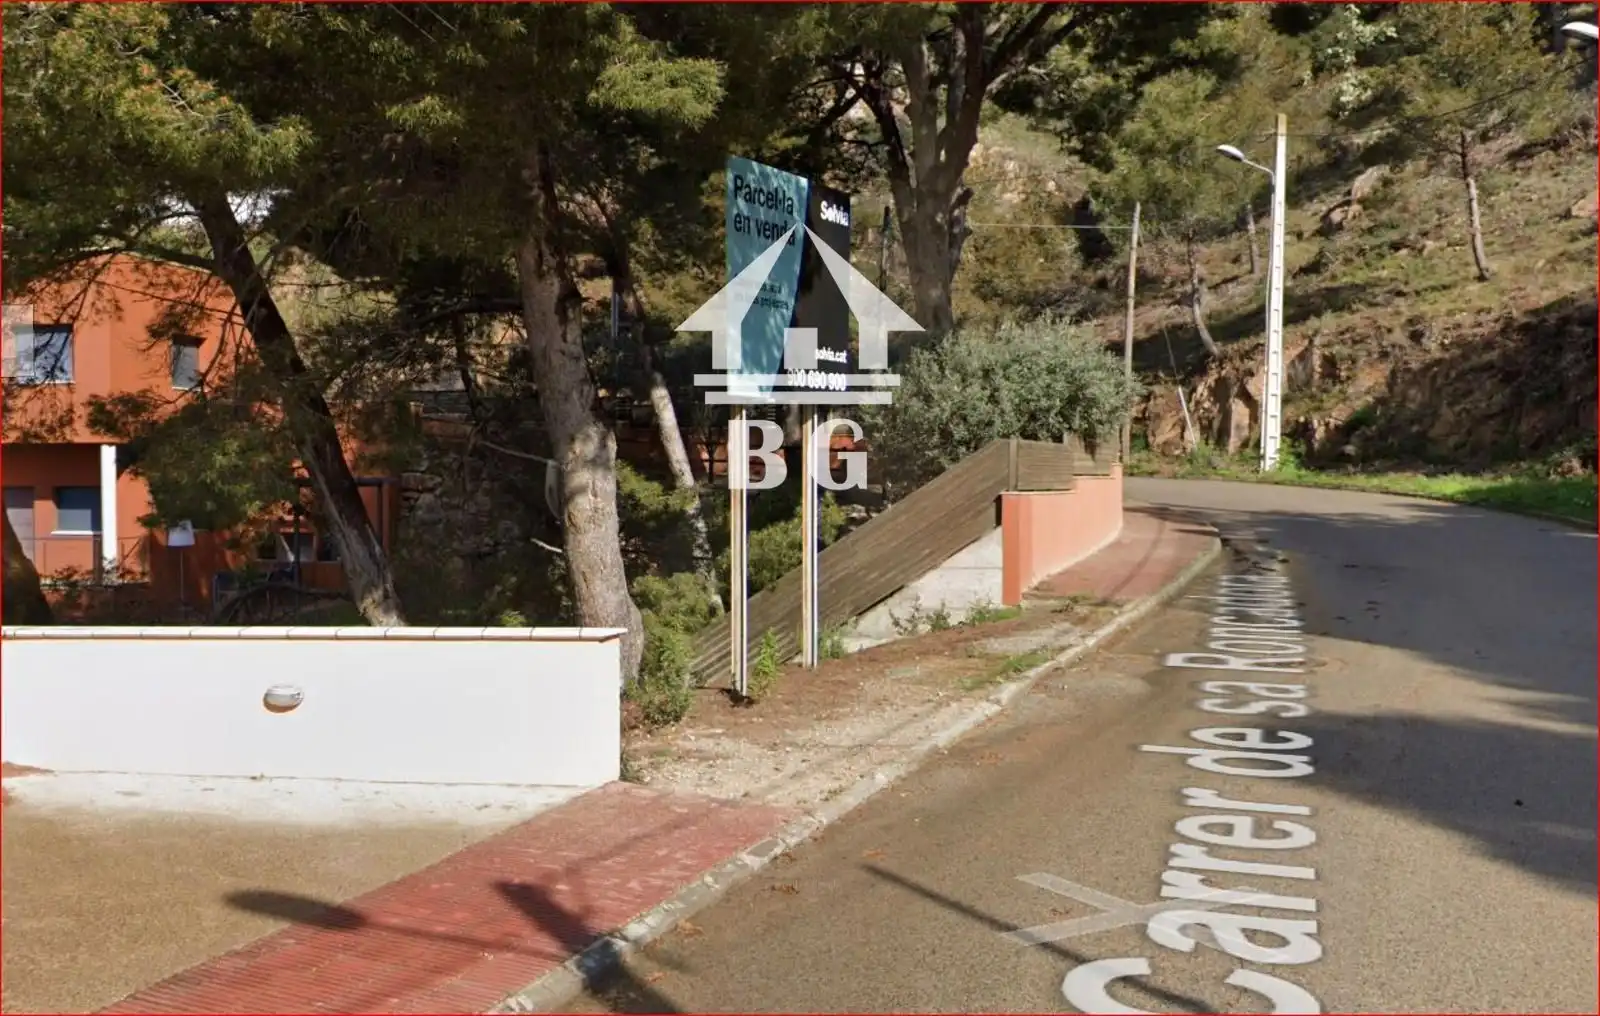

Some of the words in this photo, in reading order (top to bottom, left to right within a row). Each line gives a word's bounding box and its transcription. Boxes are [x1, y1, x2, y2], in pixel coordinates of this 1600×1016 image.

[733, 175, 795, 216] Parcel·la
[733, 212, 751, 233] en
[819, 200, 849, 227] Solvia
